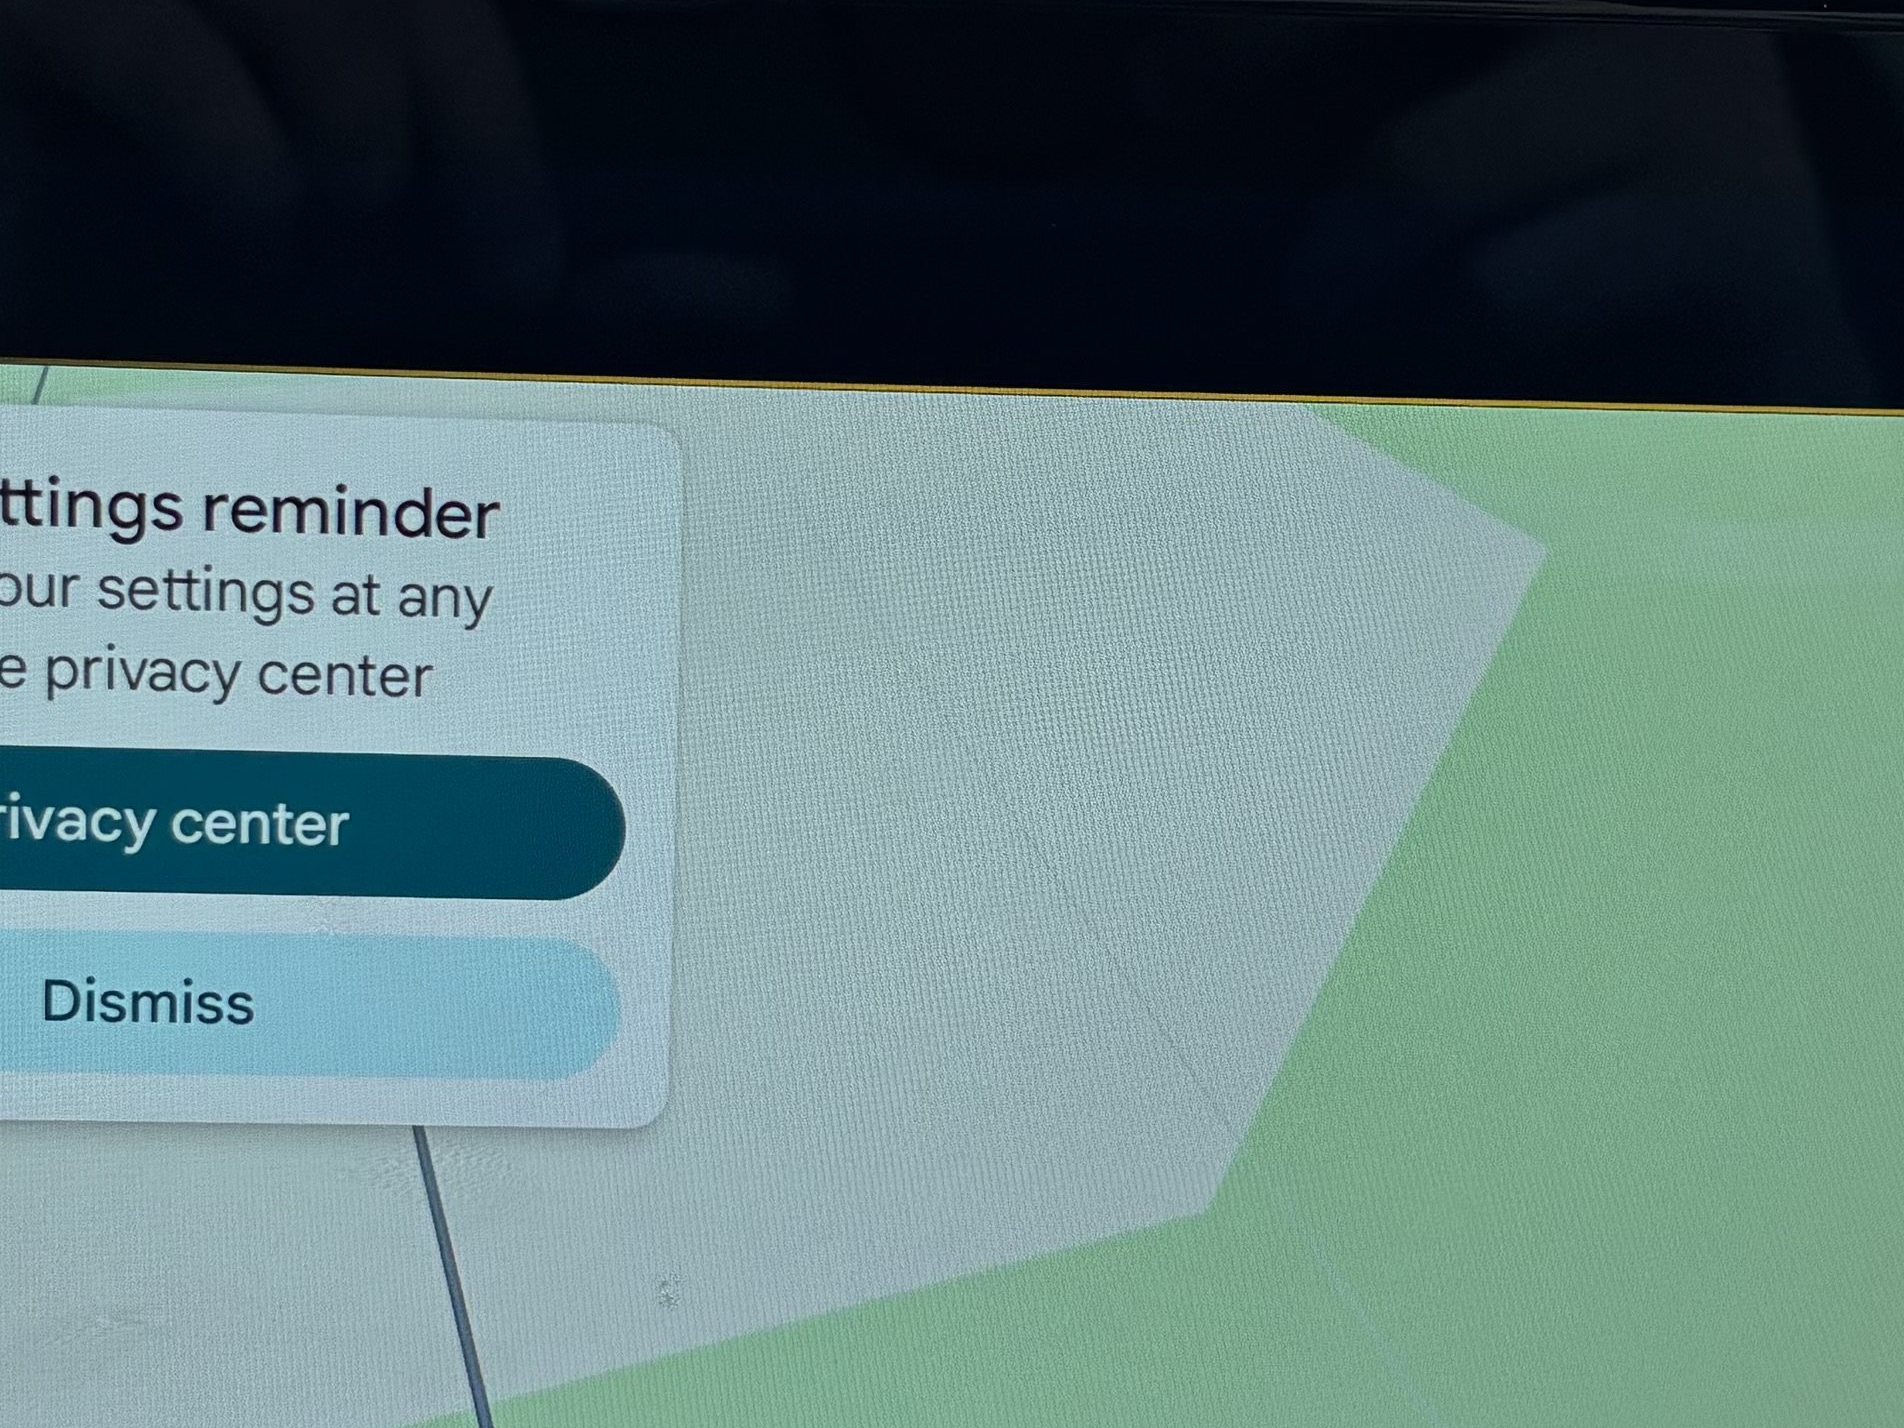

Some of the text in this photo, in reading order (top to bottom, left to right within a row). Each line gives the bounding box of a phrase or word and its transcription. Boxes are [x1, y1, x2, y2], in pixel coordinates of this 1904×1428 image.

[202, 481, 500, 541] reminder
[98, 565, 316, 627] settings
[330, 571, 382, 618] at
[397, 581, 493, 629] any
[45, 646, 242, 705] privacy
[258, 652, 432, 700] center
[172, 802, 350, 847] center
[42, 976, 254, 1027] Dismiss
